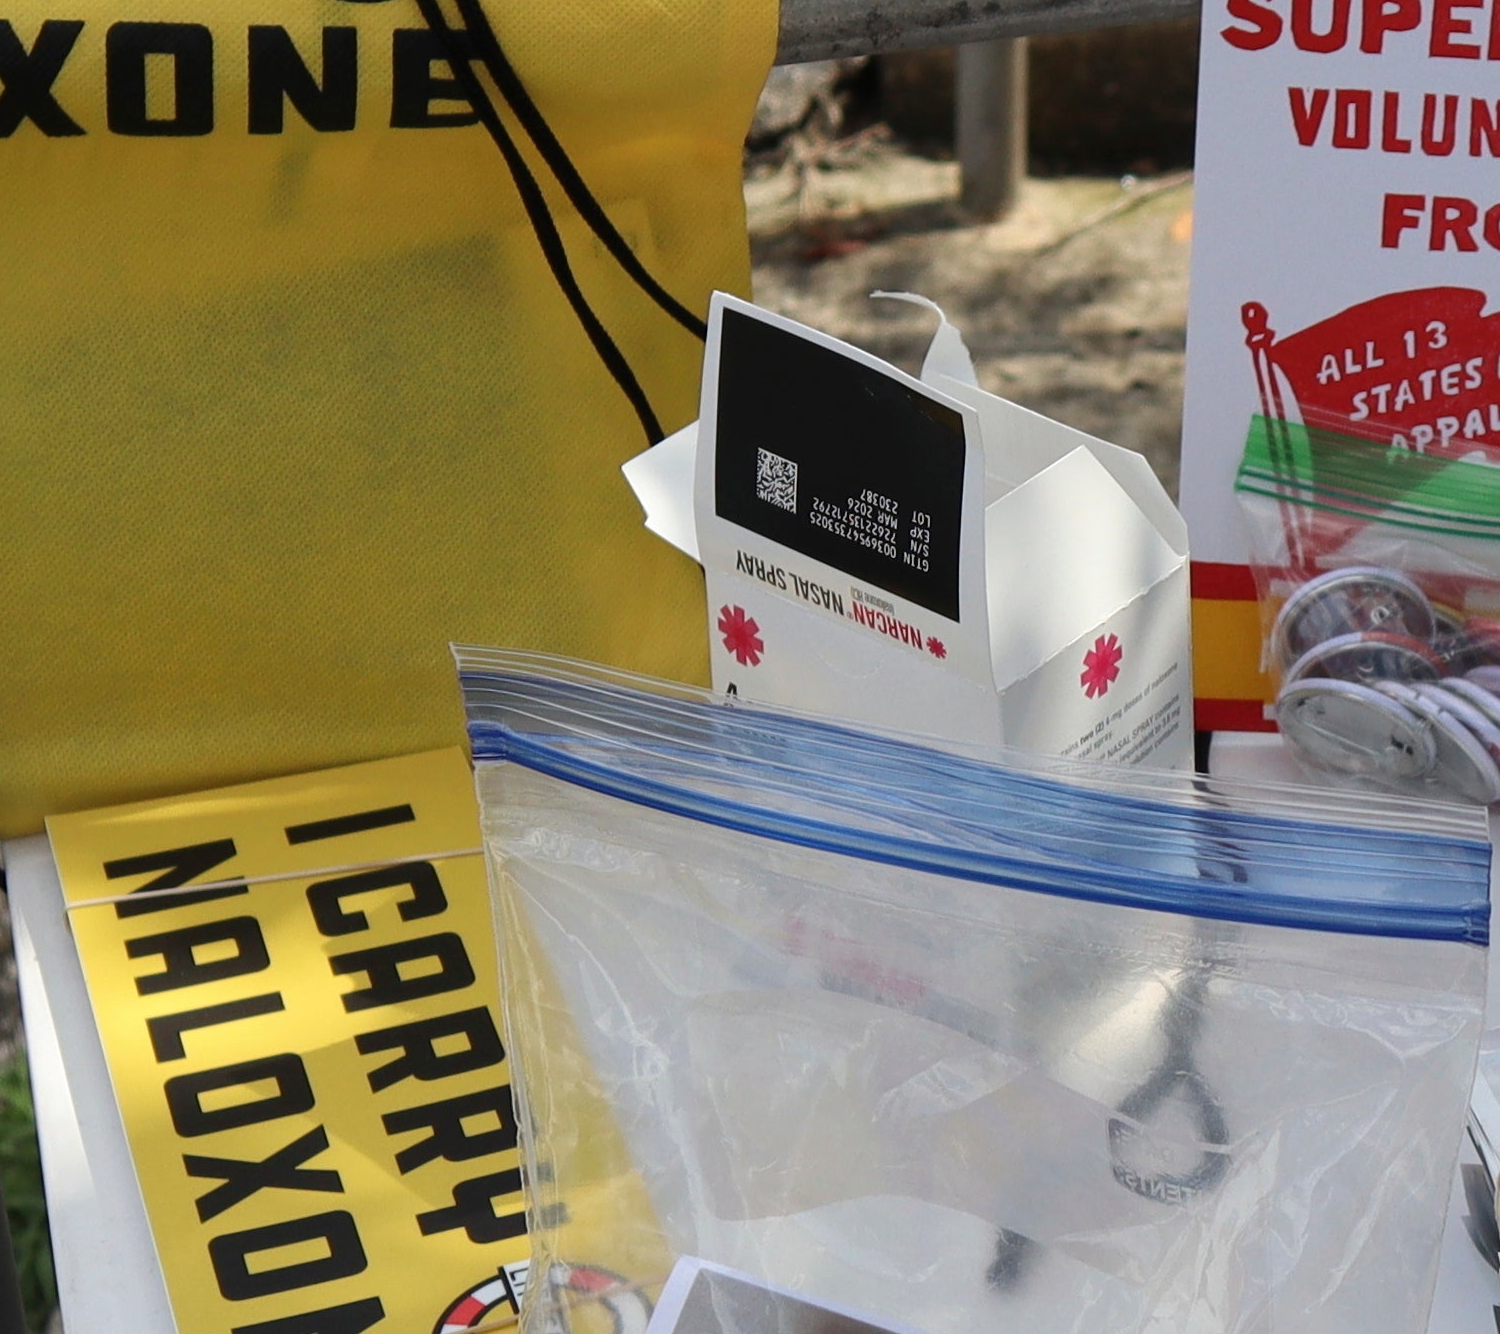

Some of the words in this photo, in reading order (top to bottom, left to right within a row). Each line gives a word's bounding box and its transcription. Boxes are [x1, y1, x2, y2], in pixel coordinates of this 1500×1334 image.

[1316, 341, 1384, 385] ALL
[1403, 321, 1449, 360] 13
[1349, 356, 1482, 422] STATES
[847, 497, 873, 517] 2026
[860, 488, 899, 515] 230387
[876, 510, 898, 530] MAR
[912, 510, 931, 527] LOT
[909, 526, 930, 543] EXP
[909, 538, 930, 557] S/N
[736, 549, 788, 591] SPRAY
[903, 551, 930, 573] GTIN
[789, 571, 845, 616] NASAL
[284, 803, 417, 845] I
[305, 861, 568, 1245] CARRY
